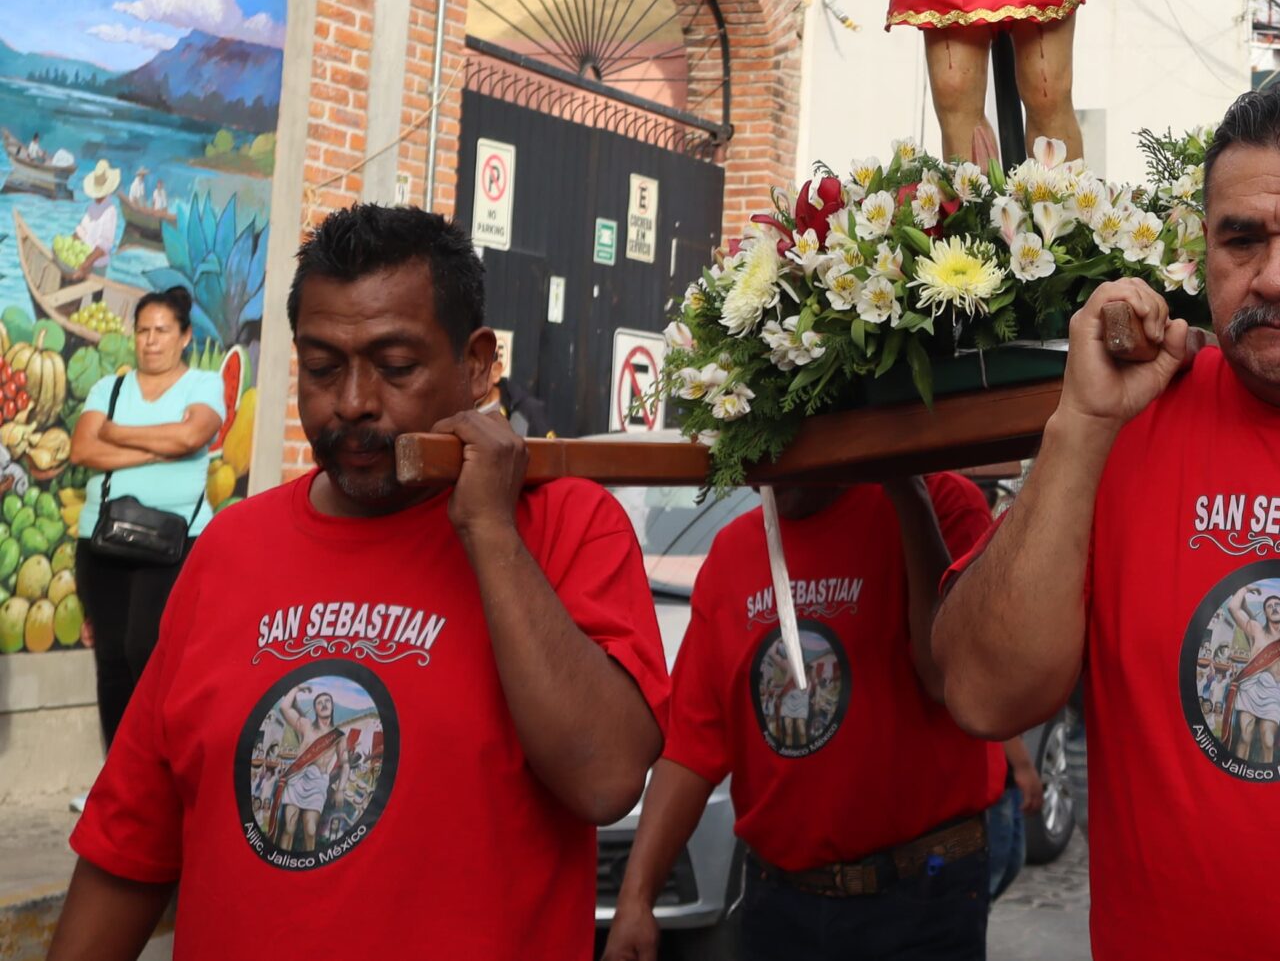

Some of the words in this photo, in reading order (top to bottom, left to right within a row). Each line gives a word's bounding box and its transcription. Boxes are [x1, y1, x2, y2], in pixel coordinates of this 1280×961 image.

[487, 209, 497, 220] NO
[639, 187, 648, 209] E
[477, 223, 505, 237] PARKING
[1194, 494, 1246, 532] SAN
[746, 586, 773, 619] SAN
[791, 577, 863, 605] EBASTIAN
[257, 602, 303, 648] SAN
[306, 601, 447, 651] SEBASTIAN
[1192, 723, 1218, 764] Ajijic,
[1221, 757, 1274, 780] Jalisco
[244, 821, 265, 856] Ajijic,
[267, 850, 315, 869] Jalisco
[318, 824, 367, 865] México
